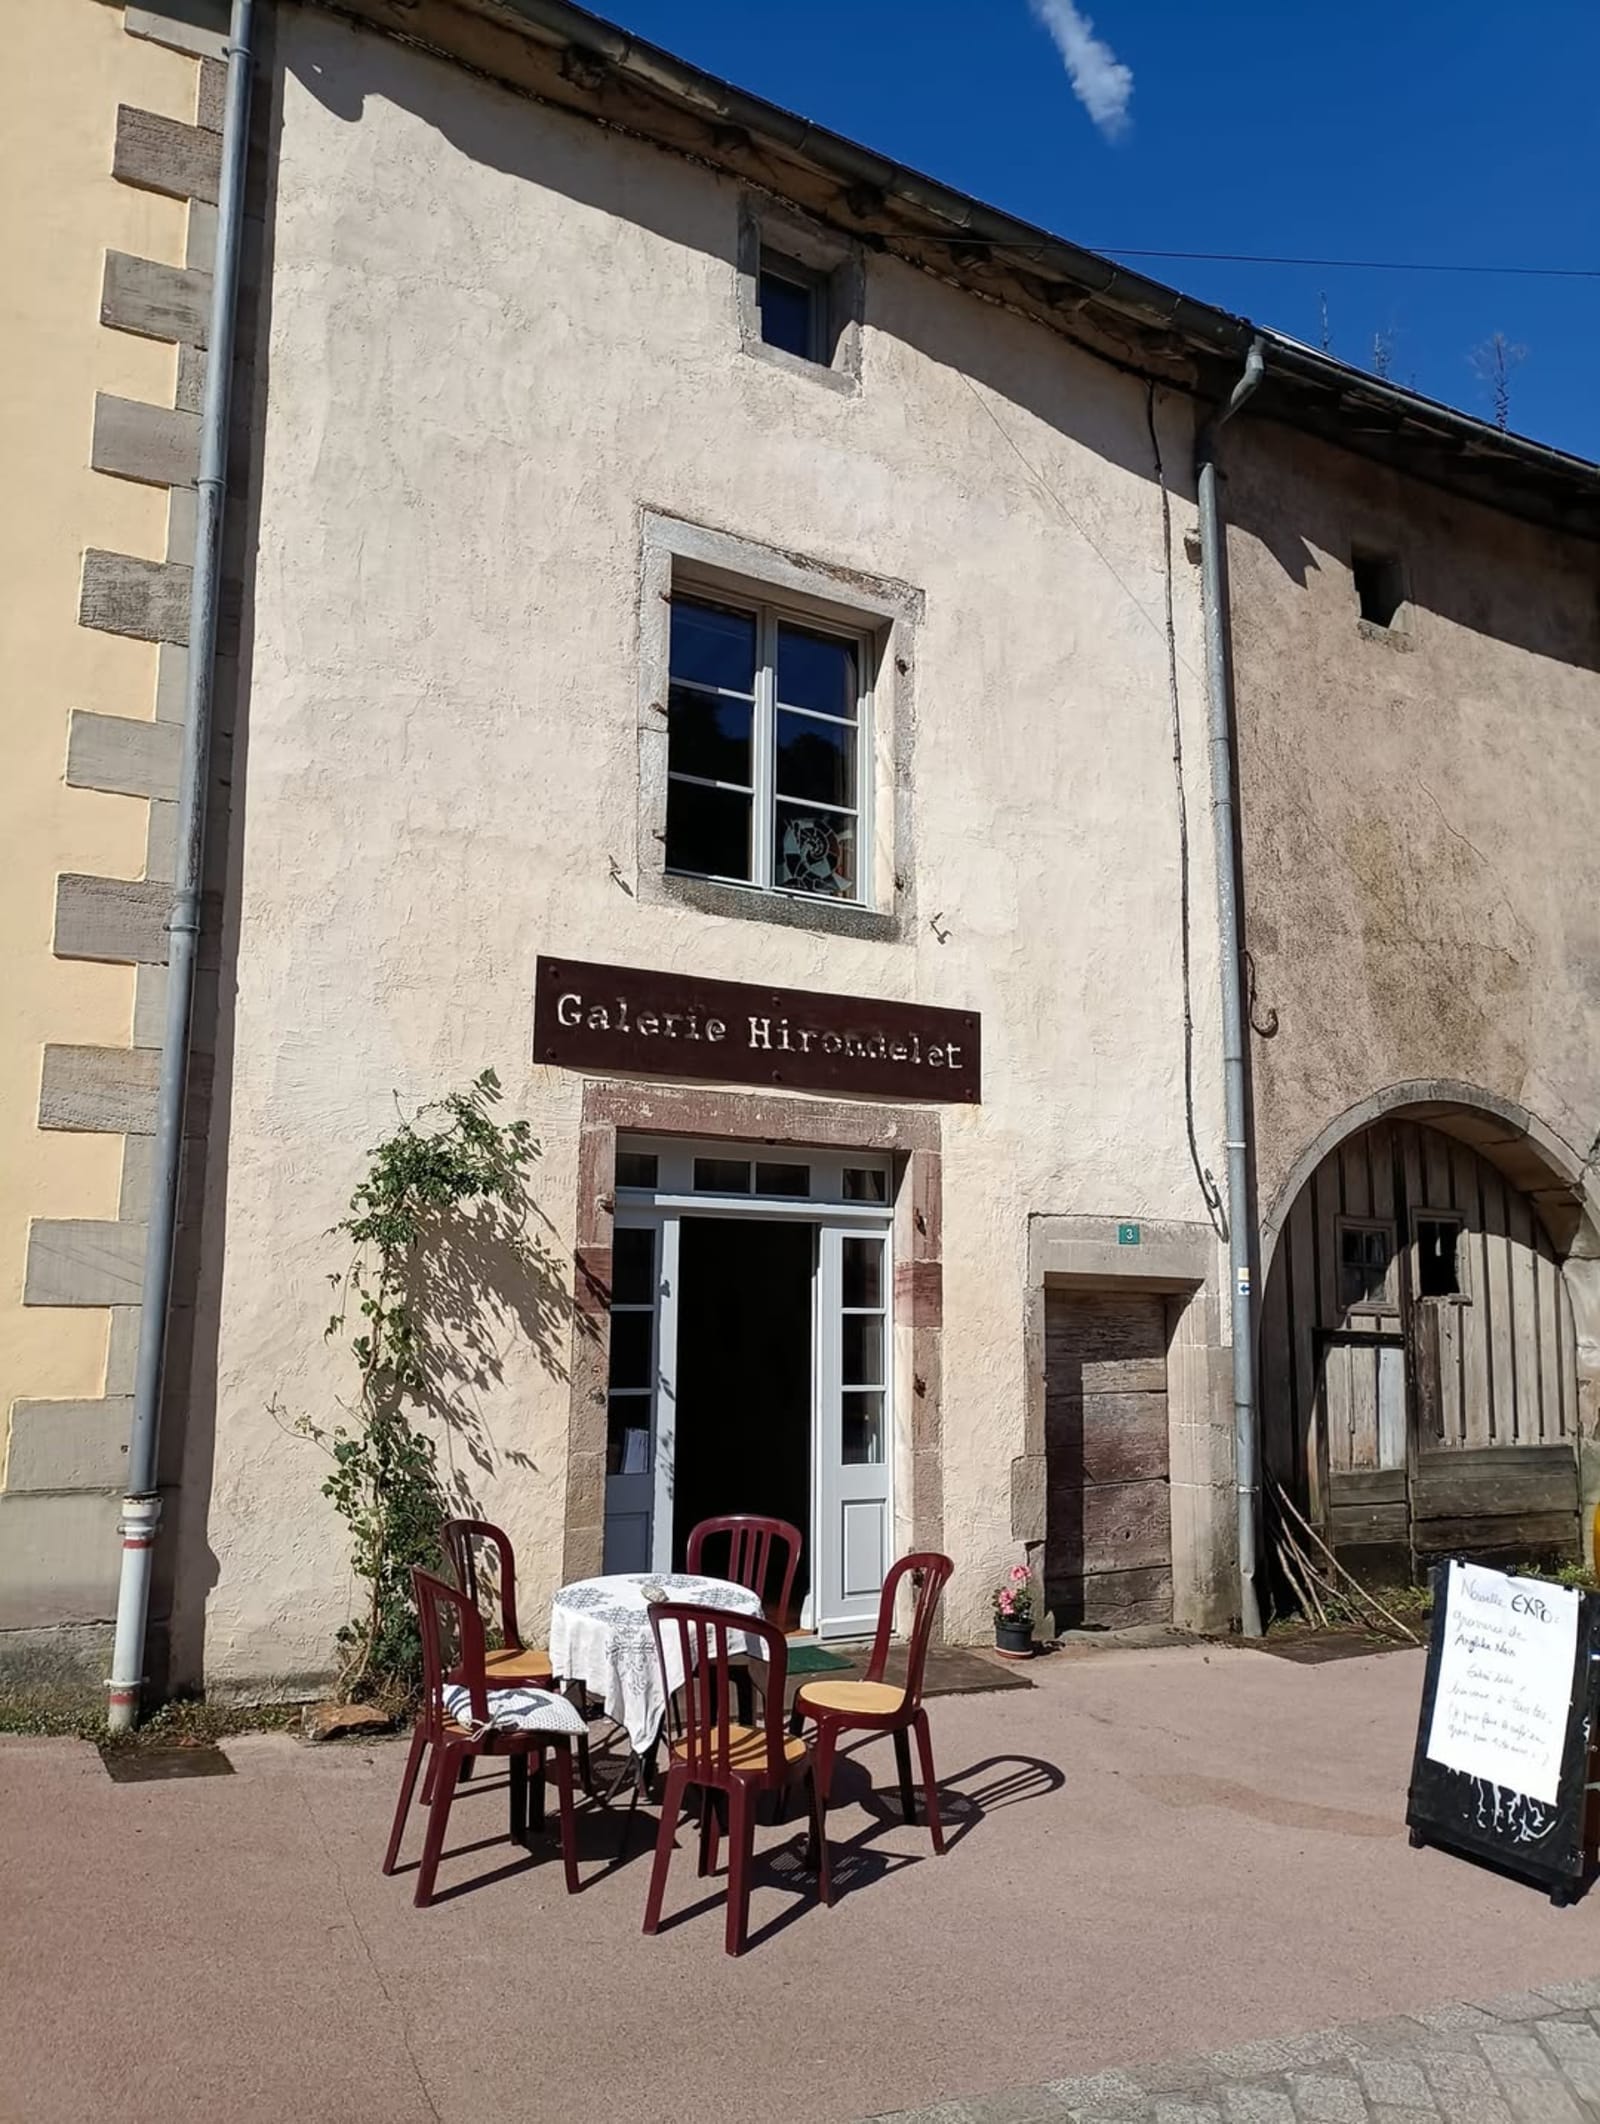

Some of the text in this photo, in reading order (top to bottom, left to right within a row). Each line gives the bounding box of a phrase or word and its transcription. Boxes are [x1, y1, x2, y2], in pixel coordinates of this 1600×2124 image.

[556, 994, 964, 1070] Galerie Hirondelet
[1125, 1228, 1134, 1240] 3
